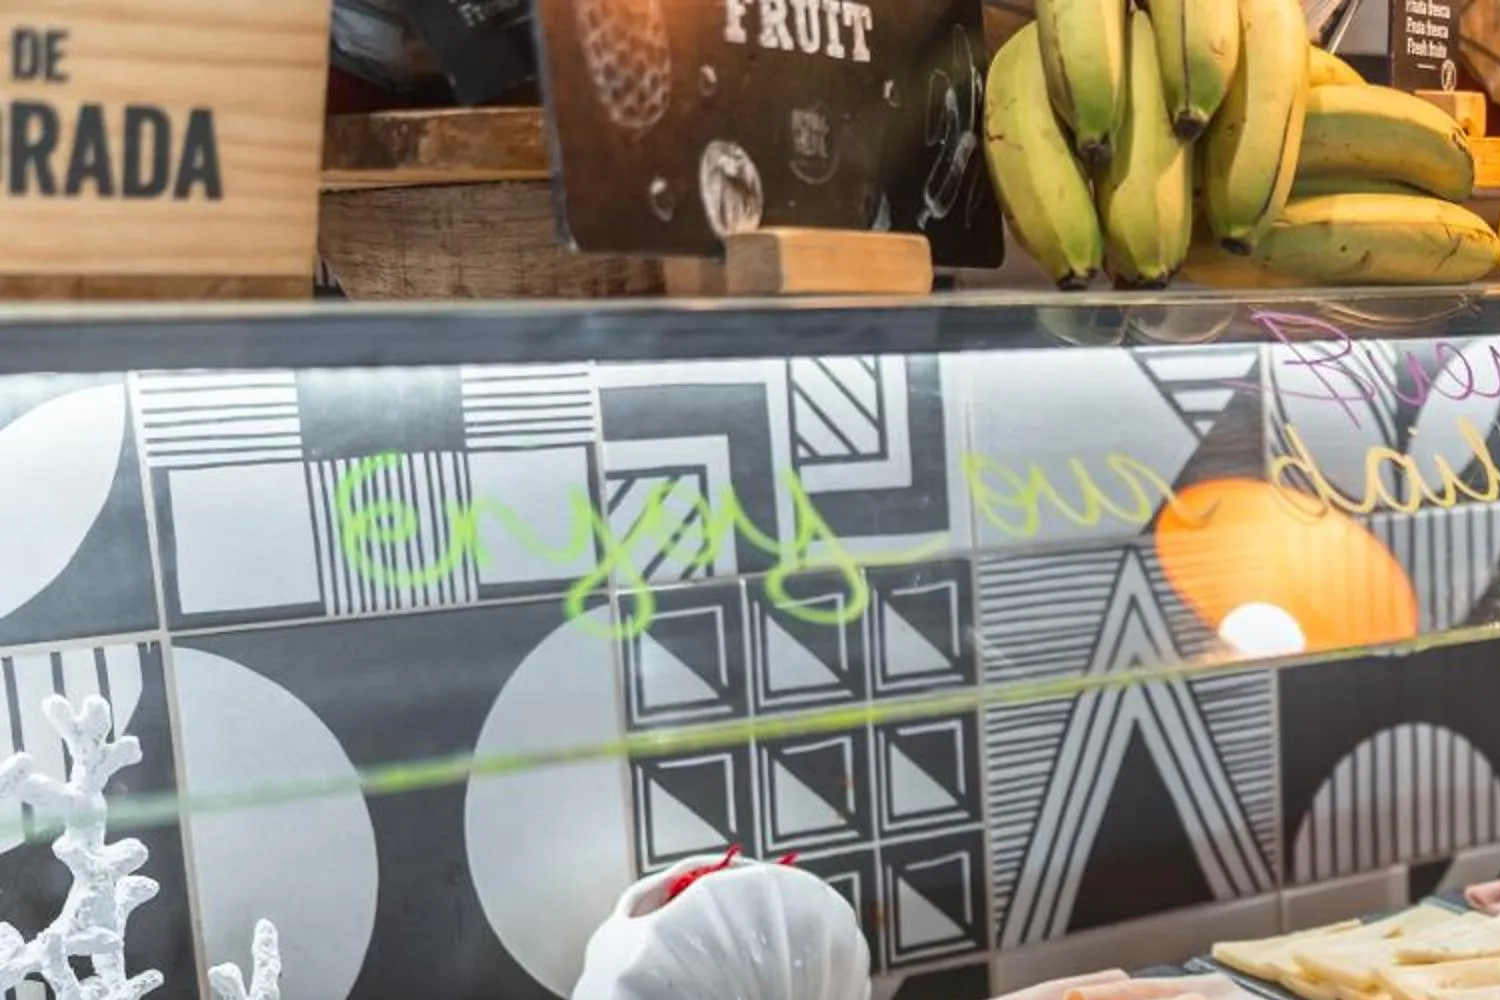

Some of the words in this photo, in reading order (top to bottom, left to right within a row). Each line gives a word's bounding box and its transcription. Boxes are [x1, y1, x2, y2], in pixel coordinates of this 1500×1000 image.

[11, 27, 70, 82] DE
[724, 0, 873, 62] FRUIT
[0, 100, 223, 201] RADA
